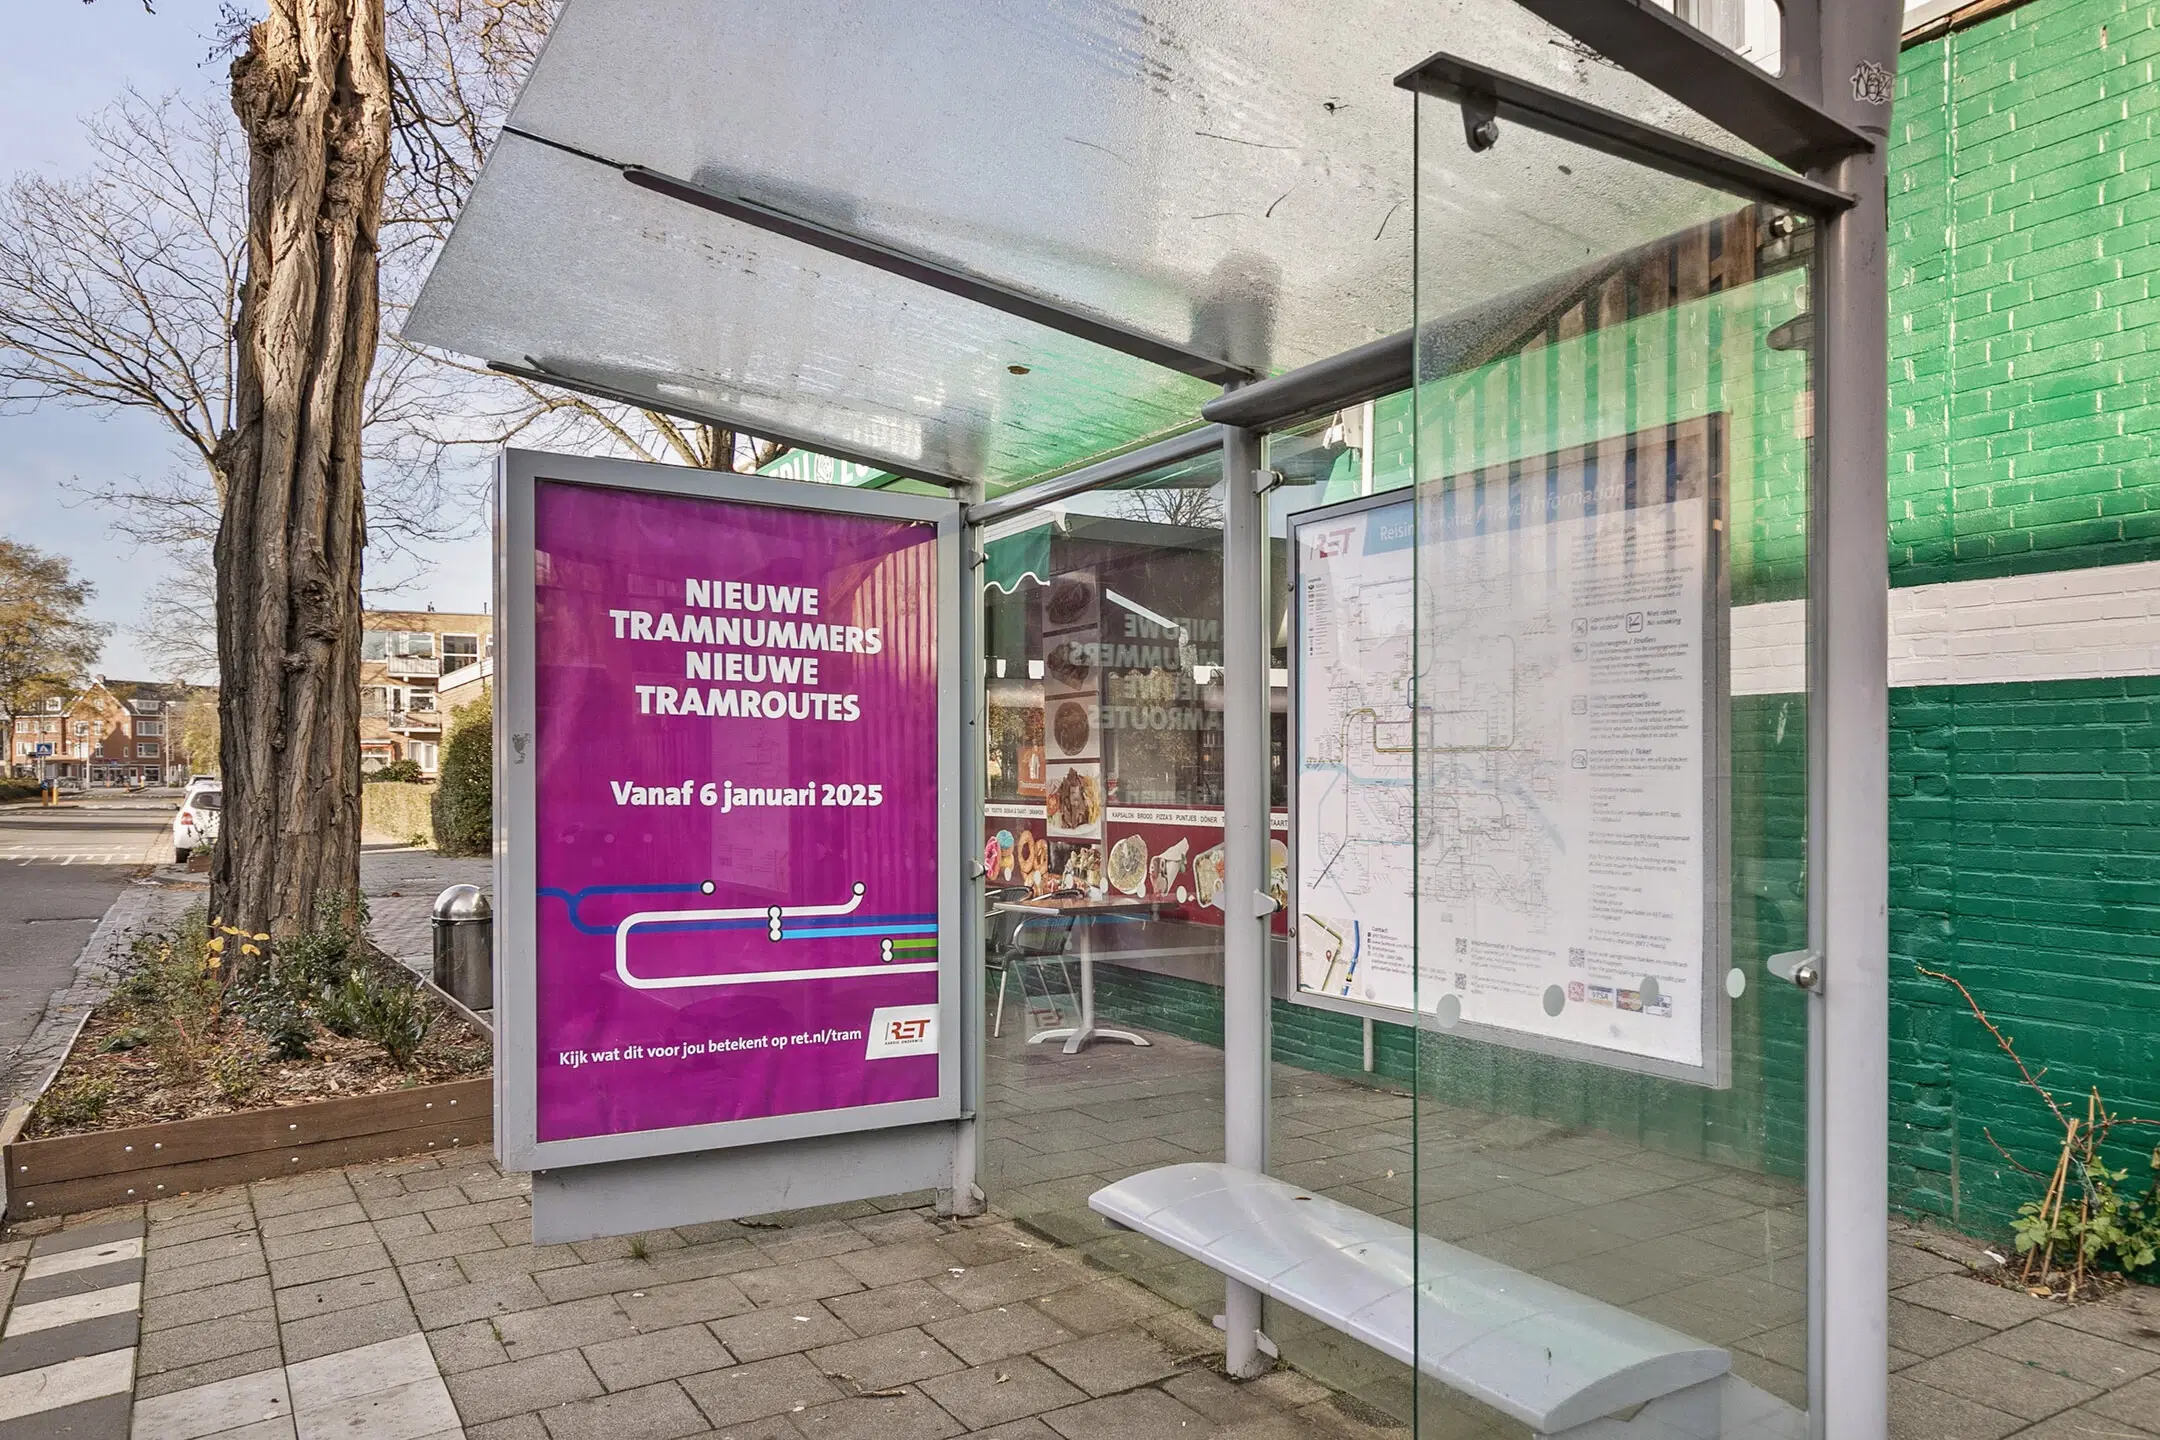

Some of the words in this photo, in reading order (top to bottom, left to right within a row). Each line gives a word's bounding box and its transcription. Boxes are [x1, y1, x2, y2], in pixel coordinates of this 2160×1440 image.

[686, 578, 819, 616] NIEUWE
[609, 609, 883, 655] TRAMNUMMERS
[686, 651, 819, 685] NIEUWE
[635, 685, 861, 722] TRAMROUTES
[610, 780, 695, 806] Vanaf
[700, 782, 718, 807] 6
[720, 780, 816, 814] januari
[821, 783, 883, 807] 2025
[1137, 812, 1153, 820] BROOD
[1175, 814, 1197, 822] PUNTJES
[891, 1019, 931, 1040] RET
[559, 1050, 589, 1069] Kijk
[591, 1047, 621, 1063] wat
[623, 1045, 644, 1060] dit
[646, 1046, 681, 1058] voor
[681, 1042, 705, 1059] jou
[708, 1035, 769, 1053] betekent
[771, 1036, 788, 1050] op
[790, 1028, 862, 1045] ret.nl/tram
